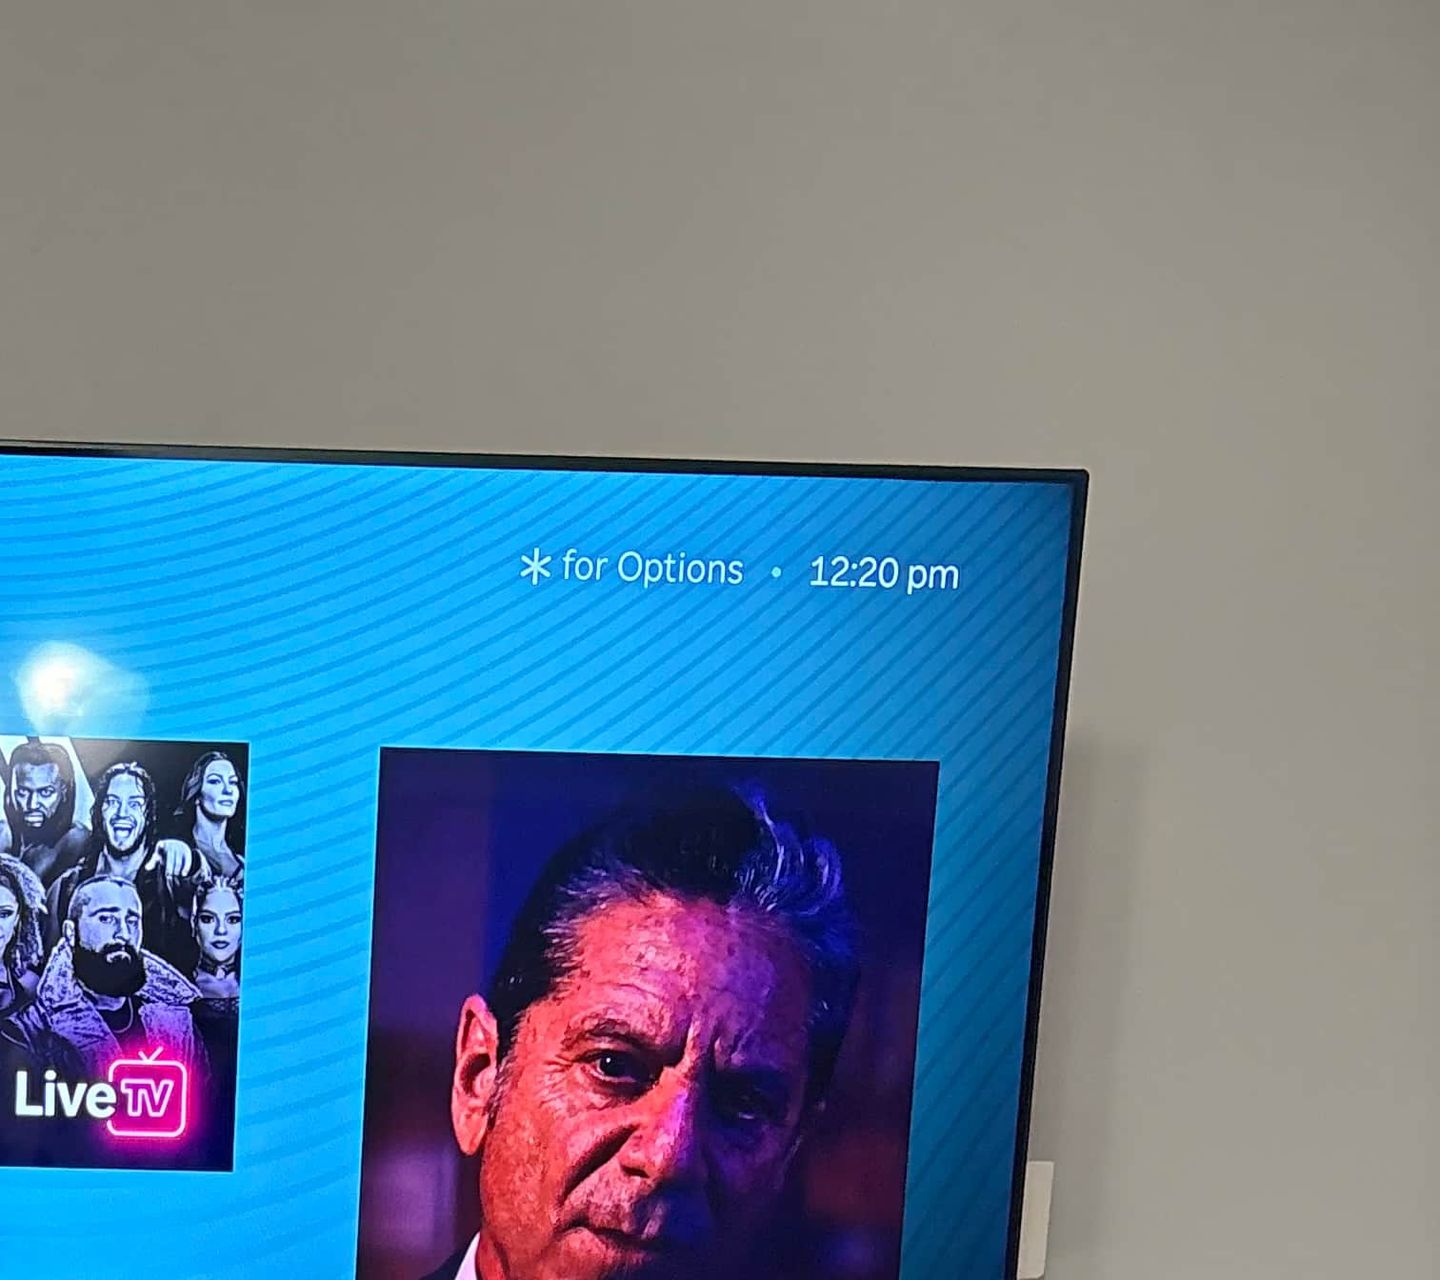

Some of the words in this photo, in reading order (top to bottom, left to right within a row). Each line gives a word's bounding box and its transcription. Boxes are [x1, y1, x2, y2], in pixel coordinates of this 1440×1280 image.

[561, 548, 608, 581] for
[617, 551, 744, 589] Options
[810, 556, 899, 589] 12:20
[906, 562, 959, 595] pm
[15, 1069, 117, 1118] Live
[121, 1077, 174, 1117] TV
